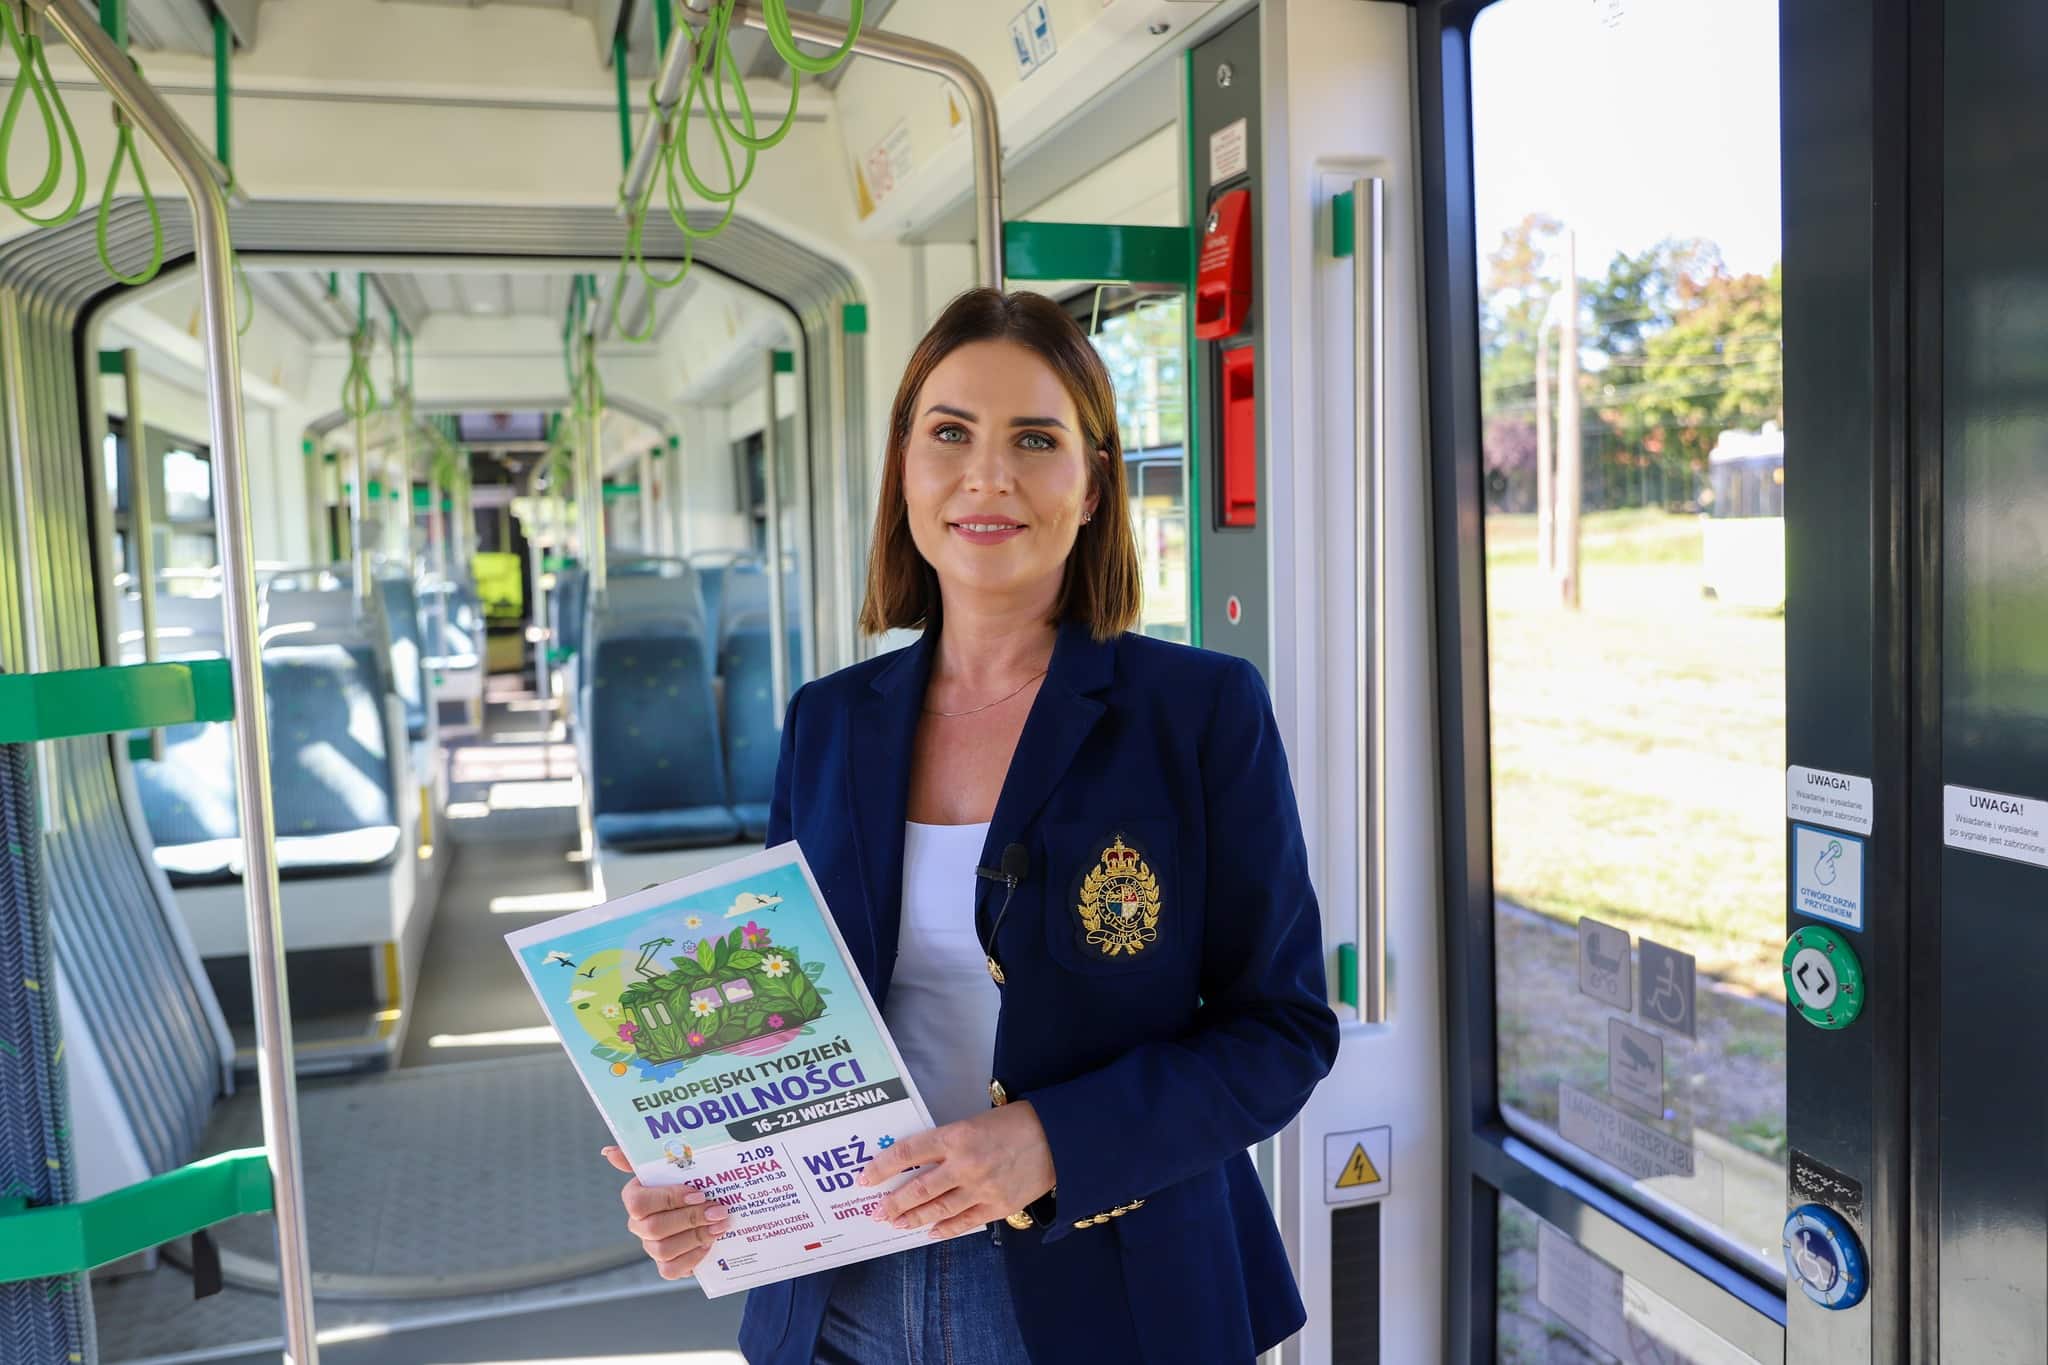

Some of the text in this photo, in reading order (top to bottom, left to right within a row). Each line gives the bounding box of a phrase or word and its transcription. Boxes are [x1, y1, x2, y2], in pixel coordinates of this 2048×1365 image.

[1807, 773, 1850, 791] UWAGA!
[1969, 795, 2024, 816] UWAGA!
[1955, 813, 1992, 827] Wsiadanie
[1998, 825, 2039, 837] wysiadanie
[1949, 828, 2046, 854] po sygnale jest zabronione
[1801, 887, 1857, 910] OTWÓRZ DRZWI
[1804, 898, 1852, 918] PRZYCISKIEM
[631, 1035, 852, 1112] EUROPEJSKI TYDZIEŃ
[644, 1058, 866, 1139] MOBILNOŚCI
[799, 1087, 889, 1121] WRZEŚNIA
[737, 1145, 774, 1163] 21.09
[803, 1134, 874, 1176] WEŹ
[716, 1160, 782, 1184] MIEJSKA
[744, 1177, 764, 1187] start
[765, 1171, 787, 1181] 10.30
[717, 1192, 746, 1206] NIK
[748, 1199, 767, 1209] MZK
[767, 1192, 798, 1203] Gorzów
[750, 1202, 791, 1215] Kostrzyńska
[737, 1219, 784, 1236] EUROPEJSKI
[784, 1211, 810, 1224] DZIEŃ
[747, 1234, 762, 1243] BEZ
[763, 1221, 814, 1239] SAMOCHODU
